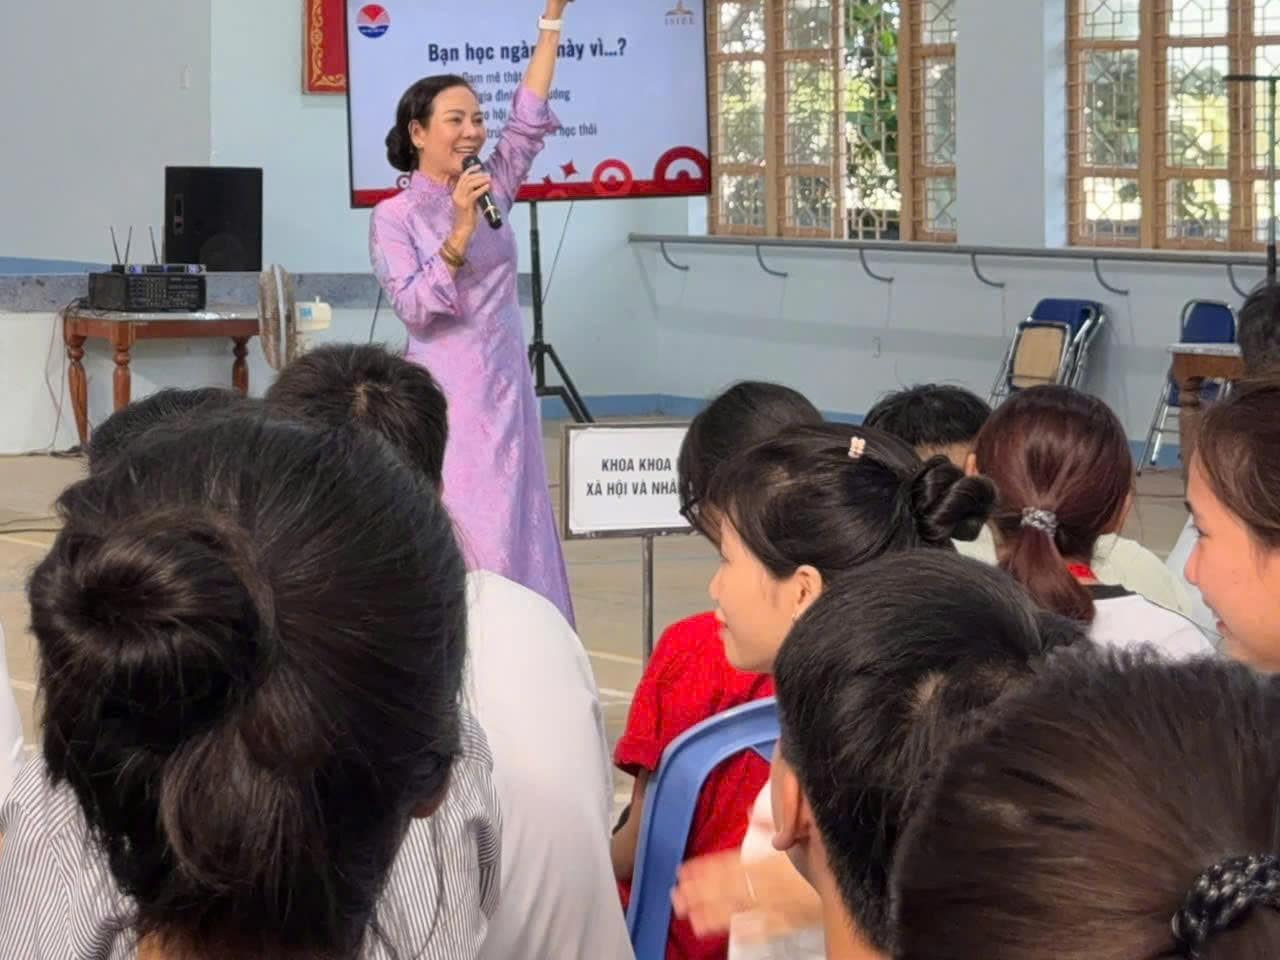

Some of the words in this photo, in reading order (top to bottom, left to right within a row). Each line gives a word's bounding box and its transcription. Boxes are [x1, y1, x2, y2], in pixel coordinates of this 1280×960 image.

[427, 43, 460, 66] Bạn
[464, 43, 495, 65] học
[601, 458, 634, 472] KHOA
[638, 457, 672, 471] KHOA
[586, 479, 602, 496] XÃ
[606, 478, 627, 499] HỘI
[631, 478, 648, 496] VÀ
[651, 477, 678, 495] NHÂ
